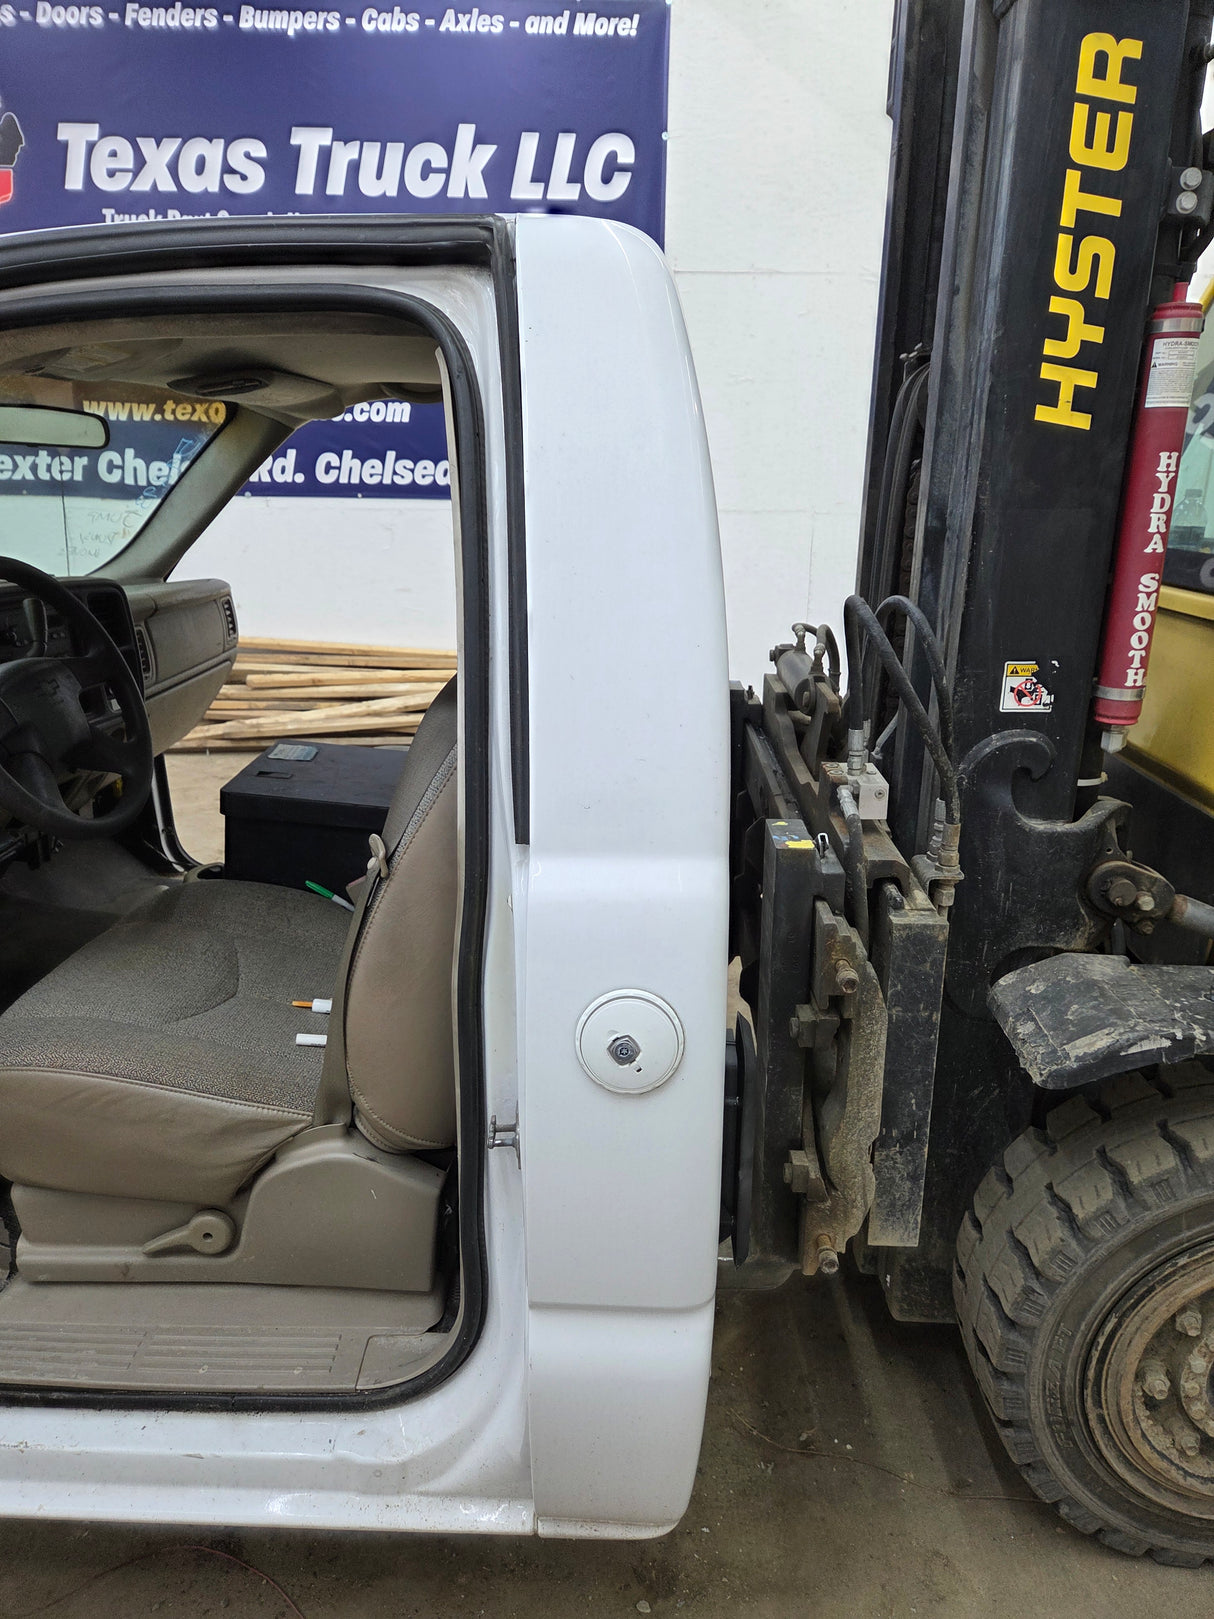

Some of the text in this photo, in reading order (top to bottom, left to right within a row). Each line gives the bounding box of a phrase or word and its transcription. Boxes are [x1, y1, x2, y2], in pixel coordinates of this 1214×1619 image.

[36, 1, 103, 26] Doors
[125, 2, 218, 28] Fenders
[239, 5, 340, 35] Bumpers
[361, 7, 420, 31] Cabs
[440, 9, 504, 33] Axles
[525, 11, 568, 34] and
[573, 13, 640, 36] More!
[57, 123, 636, 201] Texas Truck LLC
[1034, 31, 1144, 431] HYSTER
[1124, 451, 1179, 687] HYDRA SMOOTH
